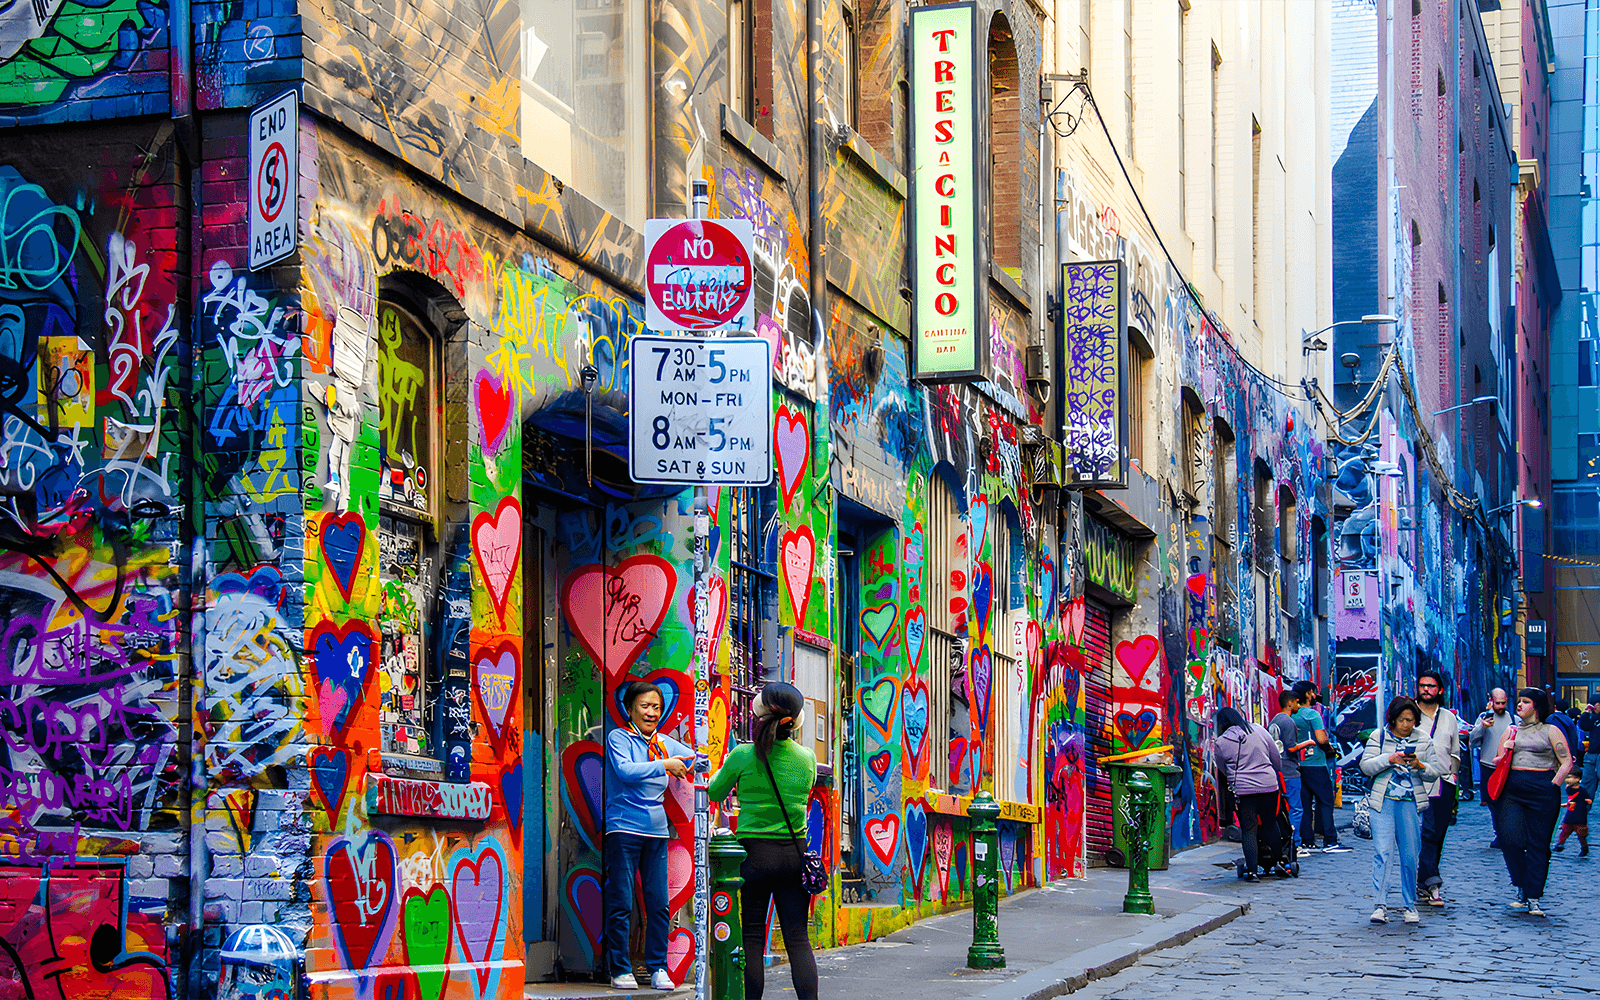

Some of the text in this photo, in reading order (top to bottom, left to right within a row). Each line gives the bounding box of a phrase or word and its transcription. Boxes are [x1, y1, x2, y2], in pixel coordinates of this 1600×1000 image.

[932, 29, 957, 145] TRES
[260, 107, 286, 141] END
[265, 155, 281, 208] S
[254, 226, 292, 259] AREA
[684, 239, 714, 259] NO
[935, 174, 959, 318] CINCO
[924, 328, 967, 337] CANTINA
[730, 369, 750, 382] PM
[673, 437, 696, 449] AM
[730, 437, 750, 450] PM
[657, 459, 745, 474] SAT & SUN
